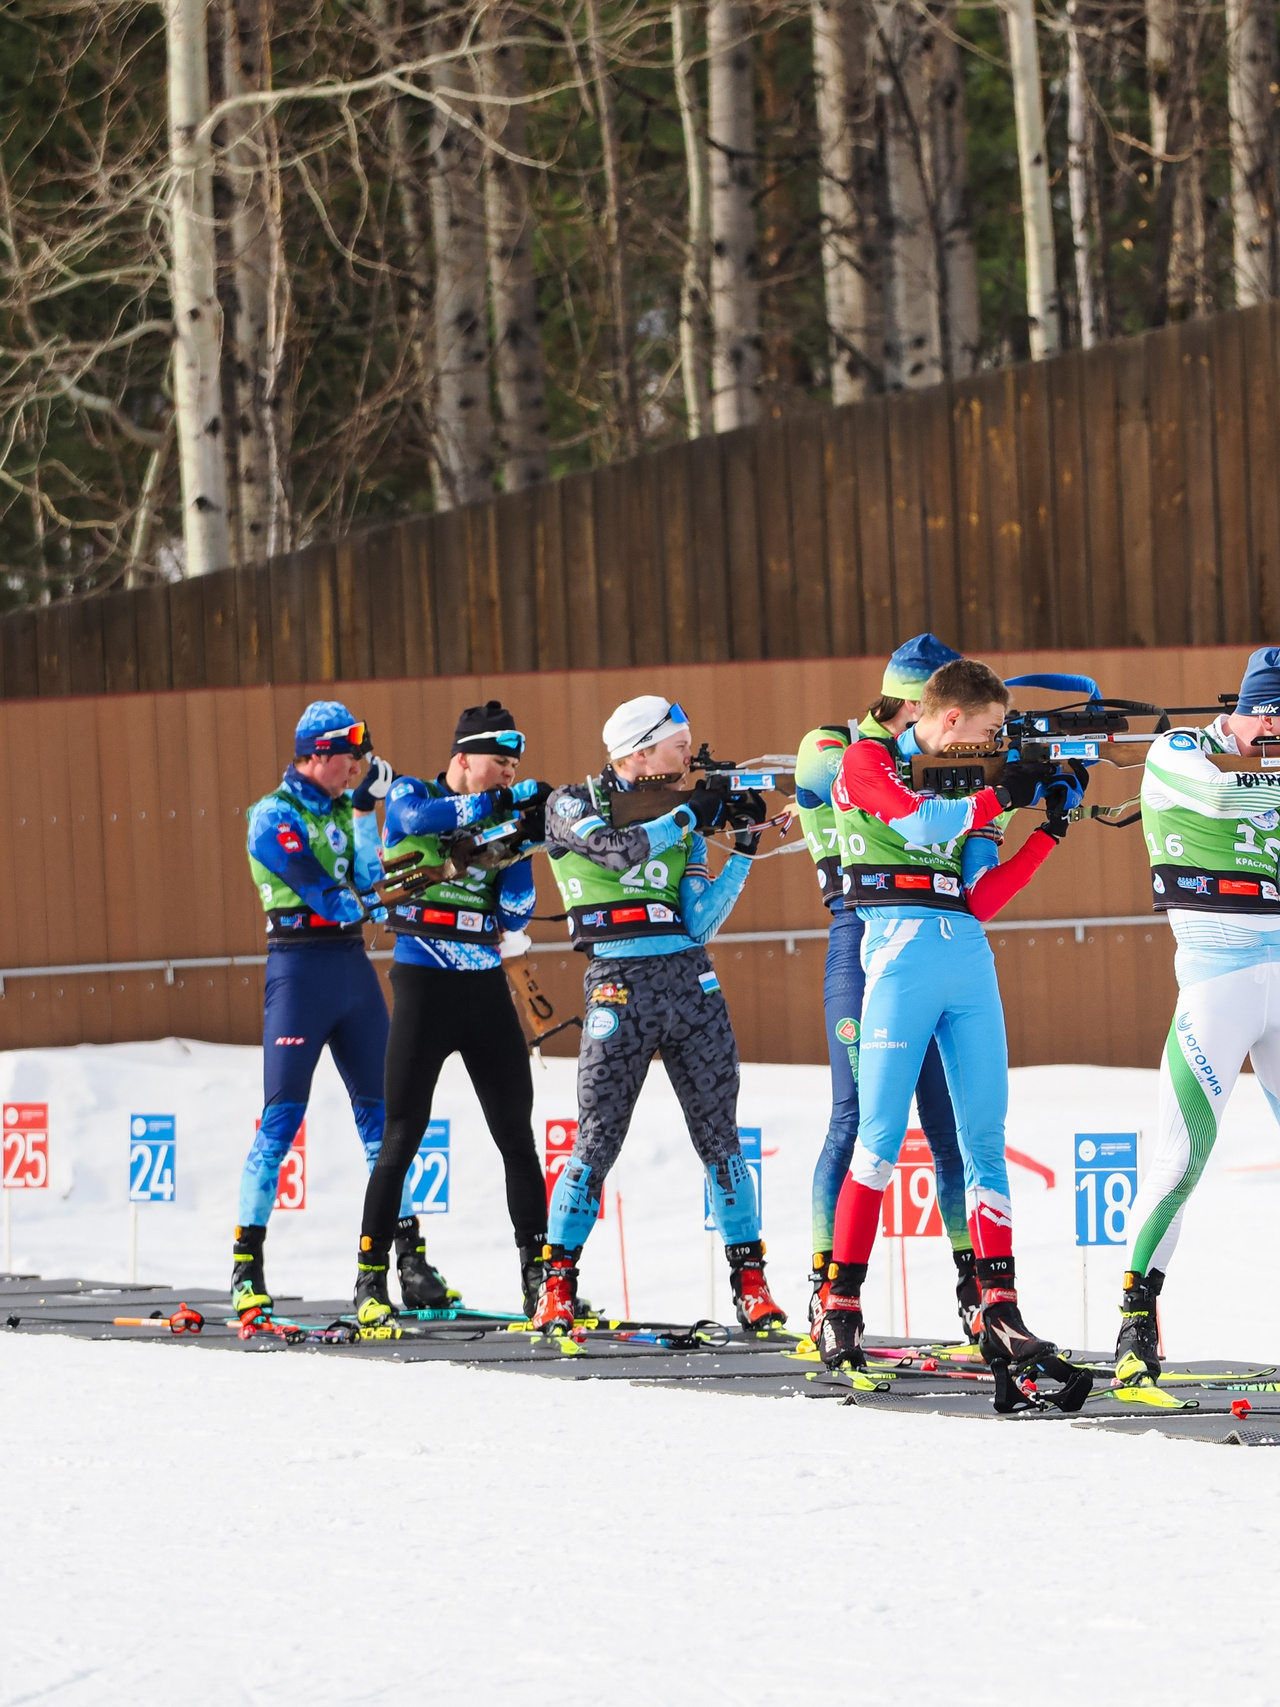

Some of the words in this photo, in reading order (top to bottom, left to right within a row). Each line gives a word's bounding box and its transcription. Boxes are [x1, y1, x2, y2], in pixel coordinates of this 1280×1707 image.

[806, 827, 837, 854] 17
[1147, 832, 1184, 858] 16
[1184, 1033, 1223, 1097] ЮГОРИЯ
[4, 1132, 47, 1188] 25
[130, 1144, 174, 1200] 24
[273, 1150, 305, 1209] 3
[410, 1151, 448, 1212] 22
[887, 1167, 937, 1235] 19
[1079, 1172, 1132, 1243] 18
[990, 1261, 1008, 1271] 170
